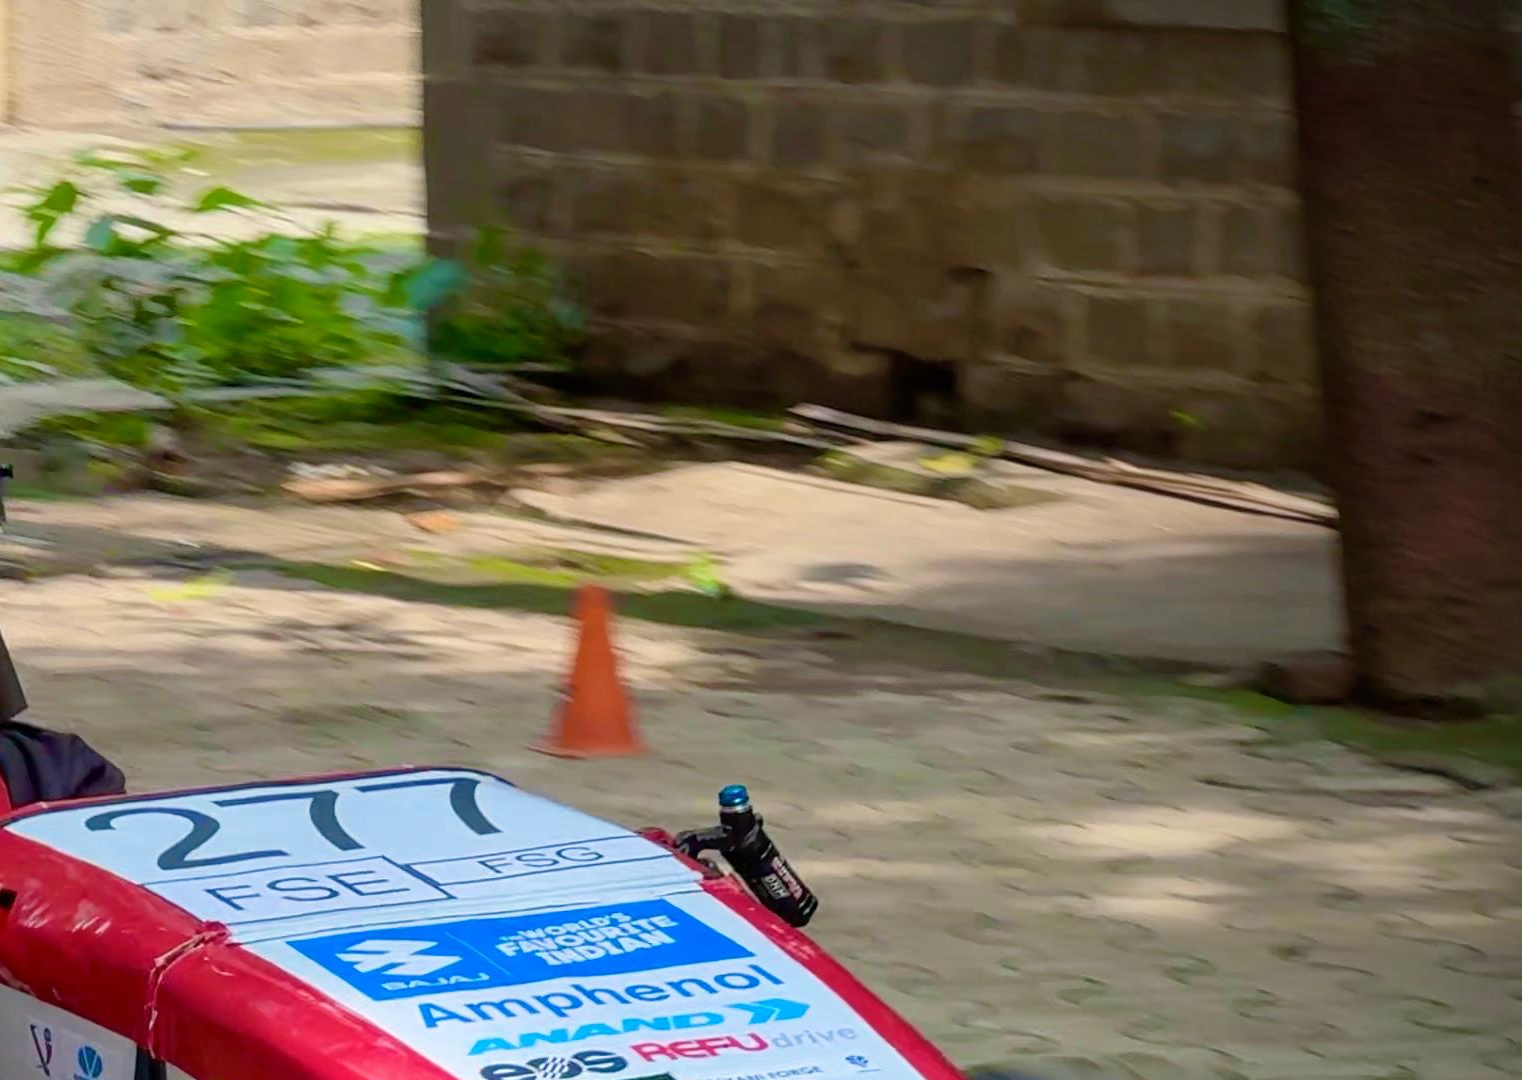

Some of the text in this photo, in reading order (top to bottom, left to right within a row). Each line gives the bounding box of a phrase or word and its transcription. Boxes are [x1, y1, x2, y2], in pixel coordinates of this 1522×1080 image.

[85, 777, 504, 871] 277
[475, 845, 604, 875] FSG
[205, 871, 411, 910] FSE
[495, 915, 680, 958] FAVOURITE
[517, 912, 633, 941] WORLD'S
[535, 931, 677, 967] INDIAN
[381, 972, 491, 991] BAJAJ
[418, 963, 786, 1029] Amphenol
[467, 1011, 726, 1056] ANAND
